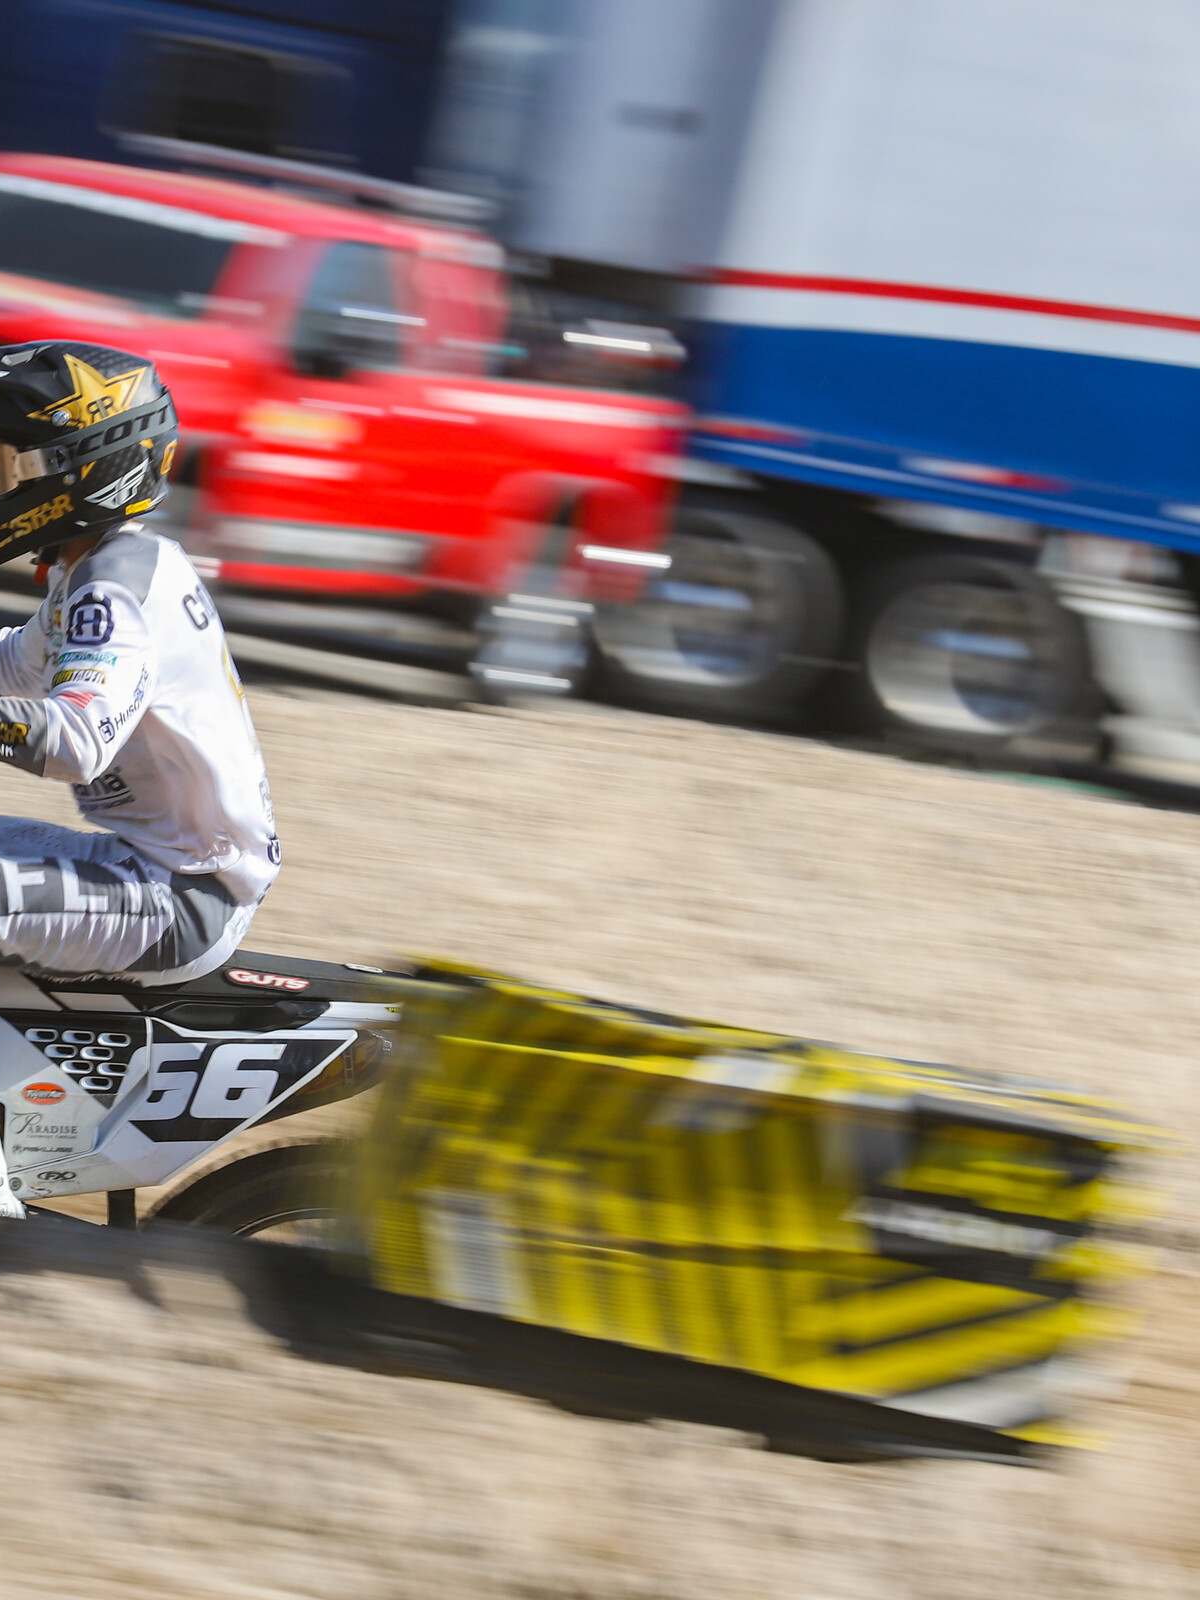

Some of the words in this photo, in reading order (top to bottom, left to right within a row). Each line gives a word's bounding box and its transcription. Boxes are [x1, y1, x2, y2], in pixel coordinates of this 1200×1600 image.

[228, 970, 310, 990] GUTS
[112, 1042, 287, 1121] 66
[9, 1112, 78, 1134] PARADISE
